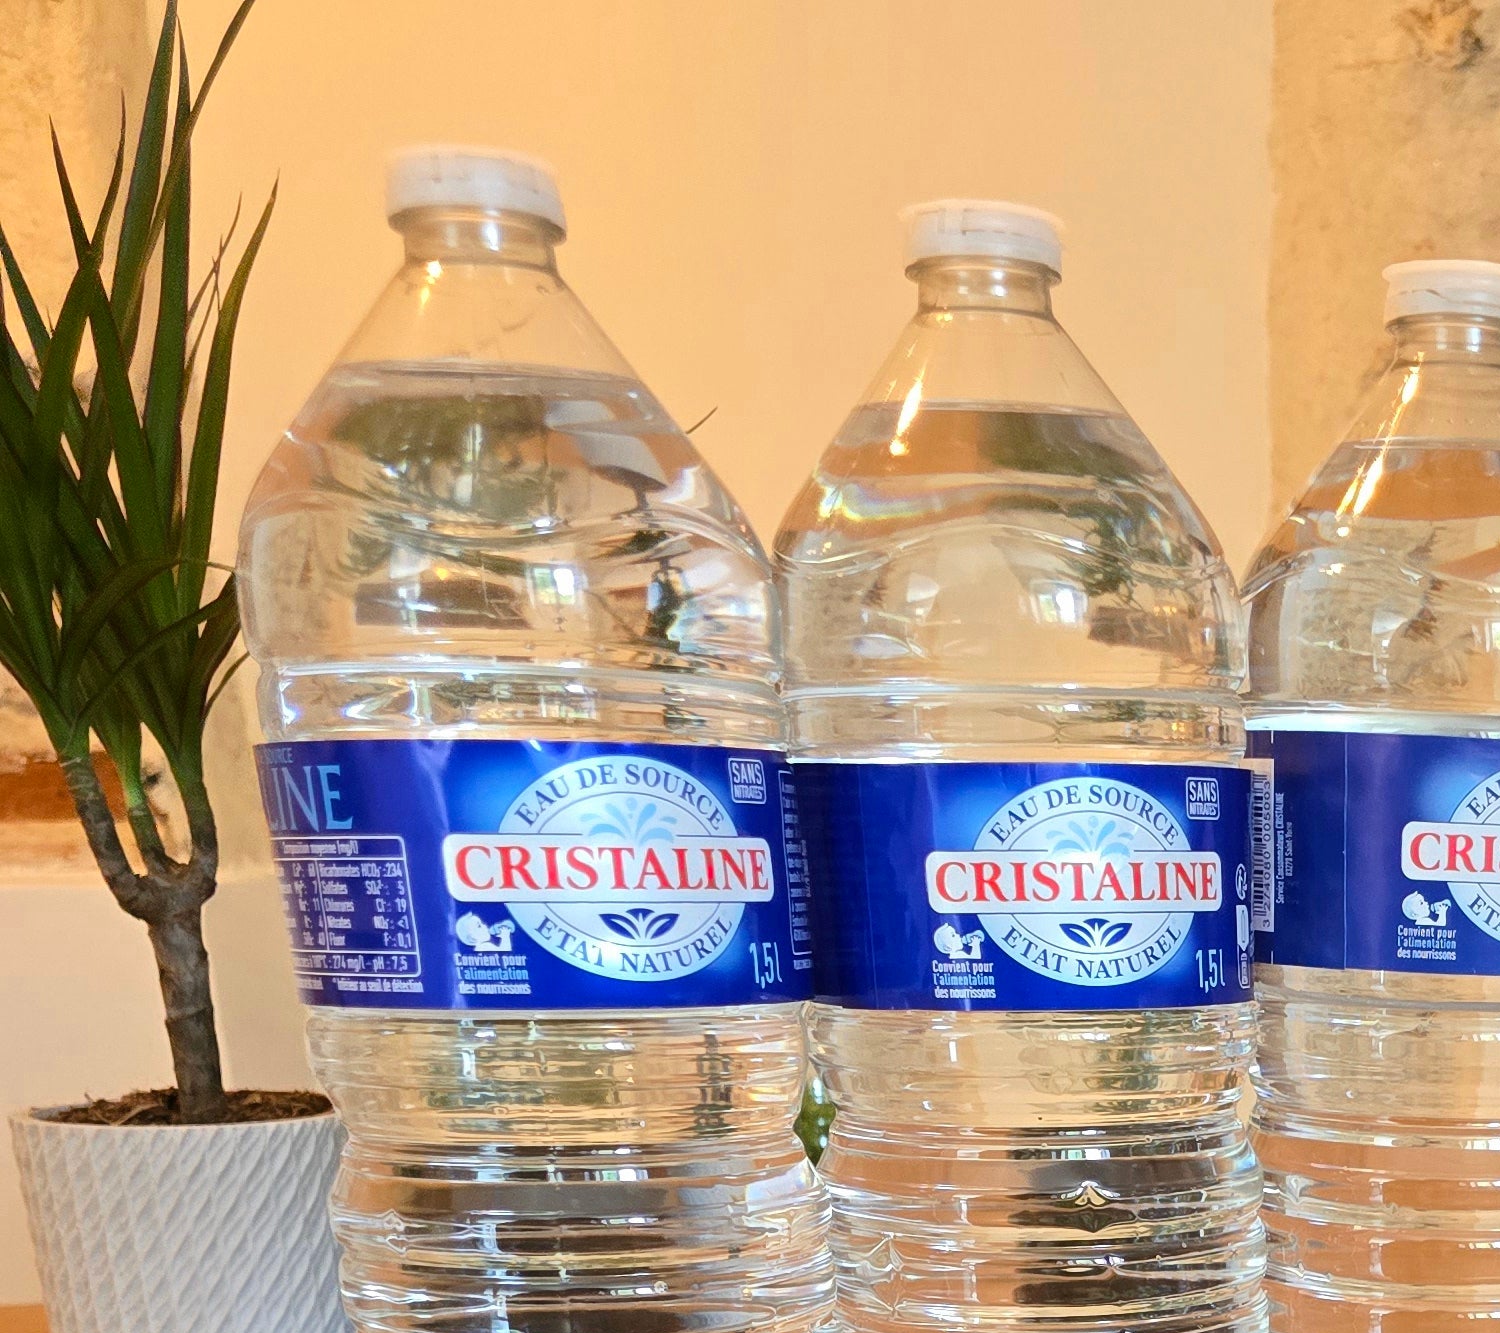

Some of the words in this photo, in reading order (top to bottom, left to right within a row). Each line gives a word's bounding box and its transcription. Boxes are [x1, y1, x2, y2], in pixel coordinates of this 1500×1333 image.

[732, 762, 763, 785] SANS
[514, 775, 571, 827] EAU
[575, 763, 618, 790] DE
[625, 763, 725, 831] SOURCE
[1189, 780, 1217, 802] SANS
[988, 795, 1039, 845] EAU
[1044, 784, 1081, 810] DE
[1088, 784, 1179, 846] SOURCE
[1275, 792, 1285, 829] CRISTALINE
[1276, 829, 1284, 880] Consommateurs
[455, 844, 769, 892] CRISTALINE
[935, 861, 1217, 903] CRISTALINE
[1275, 881, 1284, 904] Service
[395, 899, 407, 912] 19
[1263, 919, 1271, 928] 3
[1397, 924, 1435, 938] Convient
[1437, 927, 1457, 940] pour
[534, 916, 605, 967] ETAT
[619, 916, 733, 974] NATUREL
[1397, 935, 1457, 949] l'alimentation
[455, 953, 500, 966] Convient
[503, 954, 527, 967] pour
[1001, 925, 1067, 974] ETAT
[1075, 925, 1182, 979] NATUREL
[1397, 948, 1411, 959] des
[1411, 949, 1457, 961] nourrissons
[457, 967, 529, 981] l'alimentation
[932, 960, 971, 973] Convient
[973, 962, 993, 975] pour
[459, 981, 475, 995] des
[477, 982, 531, 995] nourrissons
[933, 973, 995, 986] l'alimentation
[934, 986, 949, 998] des
[949, 987, 996, 999] nourrissons
